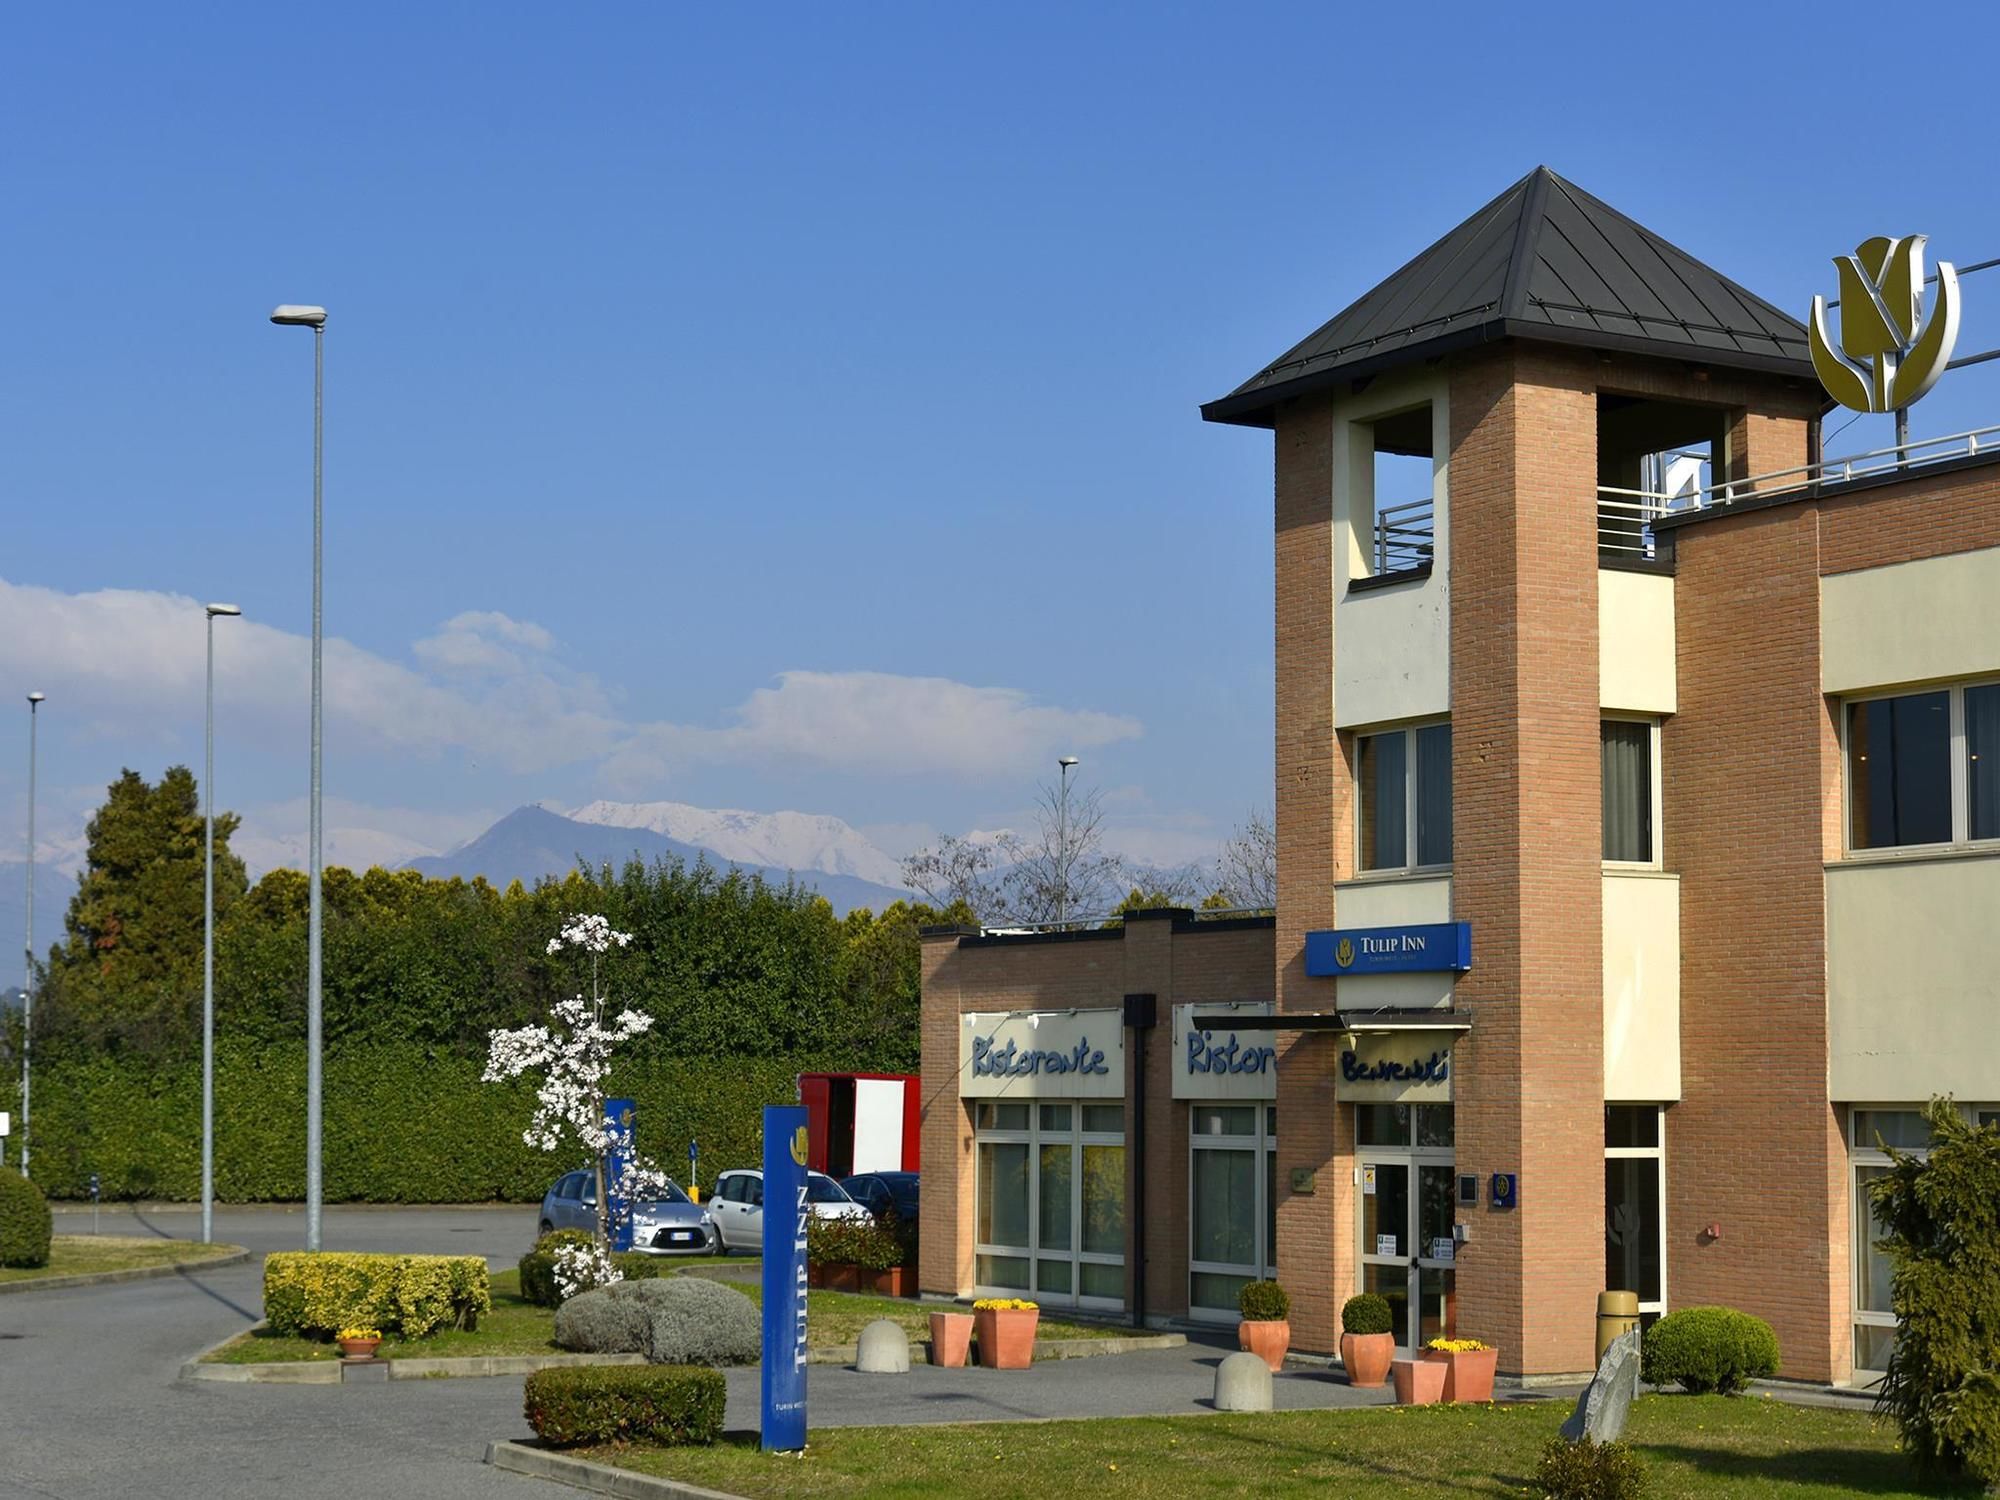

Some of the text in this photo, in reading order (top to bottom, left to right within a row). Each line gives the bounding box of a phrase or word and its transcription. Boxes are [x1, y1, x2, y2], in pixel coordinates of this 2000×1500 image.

[1361, 935, 1425, 953] TULIP INN
[972, 1035, 1109, 1077] Ristorante
[1187, 1031, 1276, 1074] Ristor
[1342, 1050, 1449, 1081] Benvenuti
[794, 1186, 808, 1374] TULIP INN
